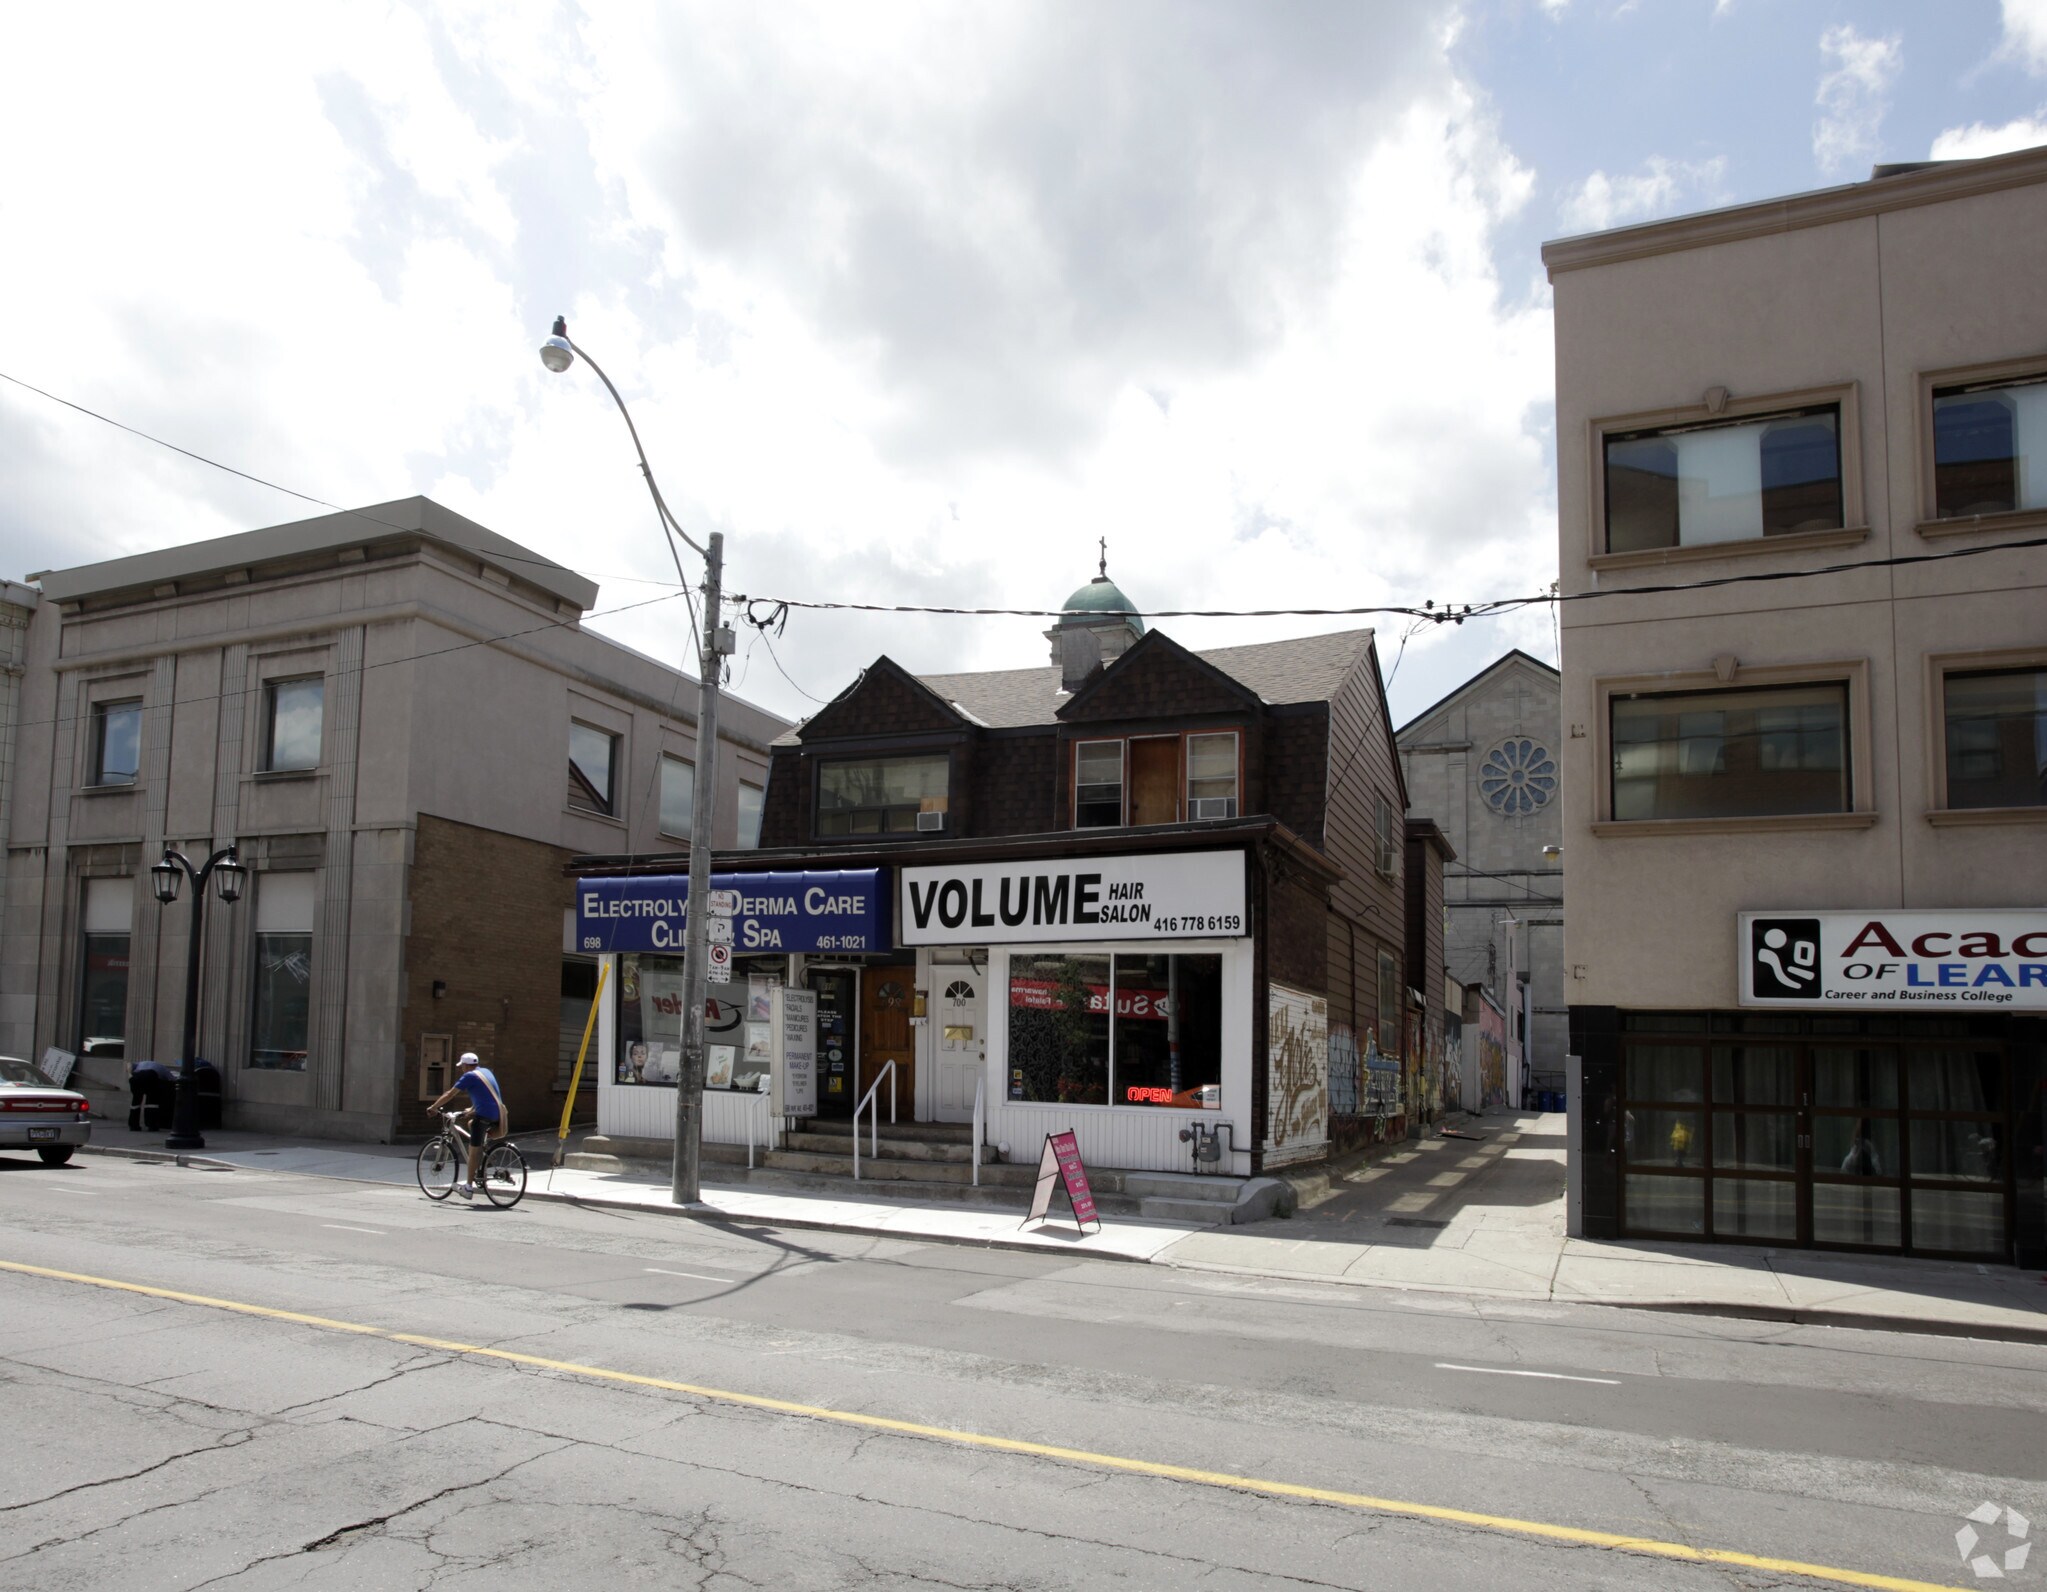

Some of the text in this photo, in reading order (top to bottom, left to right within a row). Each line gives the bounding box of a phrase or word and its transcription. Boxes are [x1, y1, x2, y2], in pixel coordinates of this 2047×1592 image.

[1109, 882, 1144, 900] HAIR
[583, 893, 688, 918] ELECTROLY
[804, 887, 866, 915] CARE
[909, 874, 1101, 929] VOLUME
[1100, 904, 1151, 924] SALON
[1154, 915, 1240, 932] 416 778 6159
[651, 920, 687, 948] CLI
[743, 919, 782, 948] SPA
[583, 937, 601, 949] 698
[816, 936, 866, 949] 461-1021
[1842, 963, 1900, 979] OF
[952, 998, 966, 1007] 700
[1825, 990, 2013, 1003] Career and Business College
[1127, 1086, 1173, 1103] OPEN
